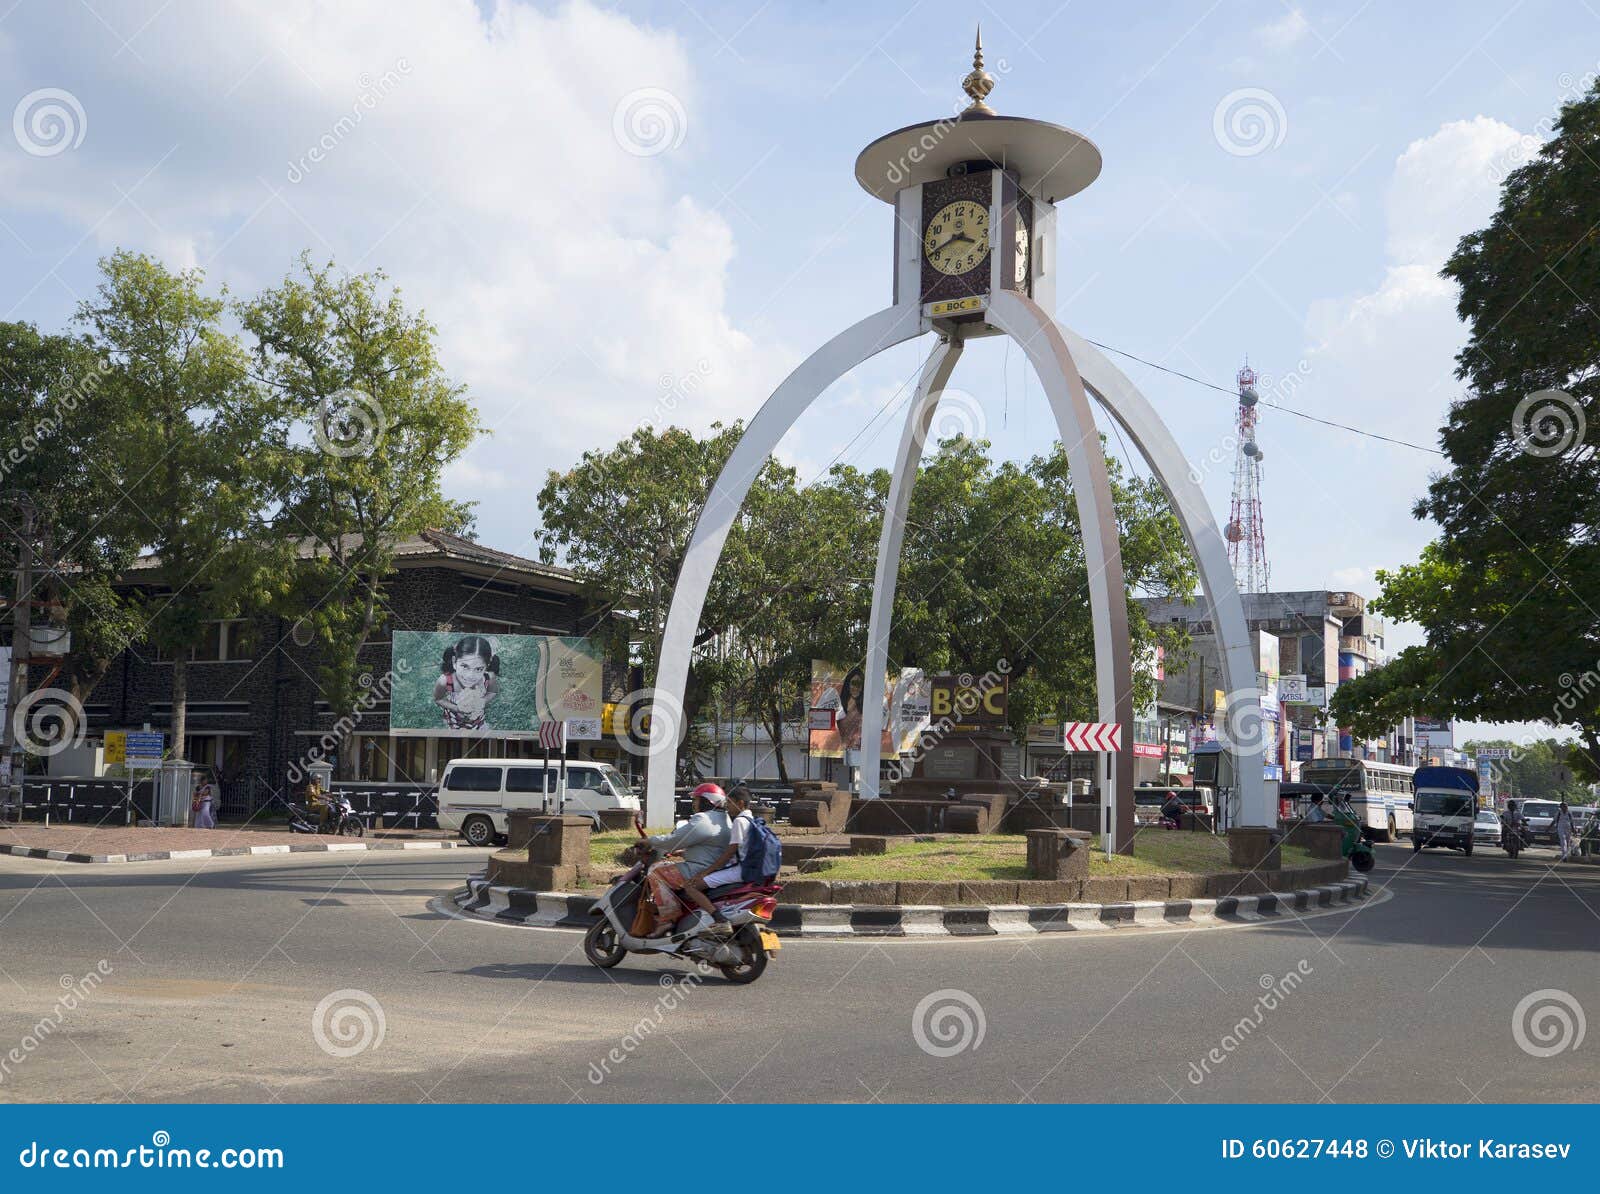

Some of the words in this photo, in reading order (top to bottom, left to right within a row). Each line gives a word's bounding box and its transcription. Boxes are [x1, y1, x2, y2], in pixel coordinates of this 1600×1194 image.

[955, 206, 965, 217] 12
[969, 208, 974, 218] 1
[943, 212, 951, 223] 11
[976, 215, 984, 225] 2
[933, 225, 942, 236] 10
[981, 228, 988, 239] 3
[930, 239, 937, 249] 9
[977, 243, 984, 253] 4
[944, 258, 951, 268] 7
[967, 255, 974, 264] 5
[955, 260, 962, 270] 6
[946, 301, 966, 311] BOC
[932, 686, 1005, 715] BOC
[1280, 693, 1304, 701] MBSL
